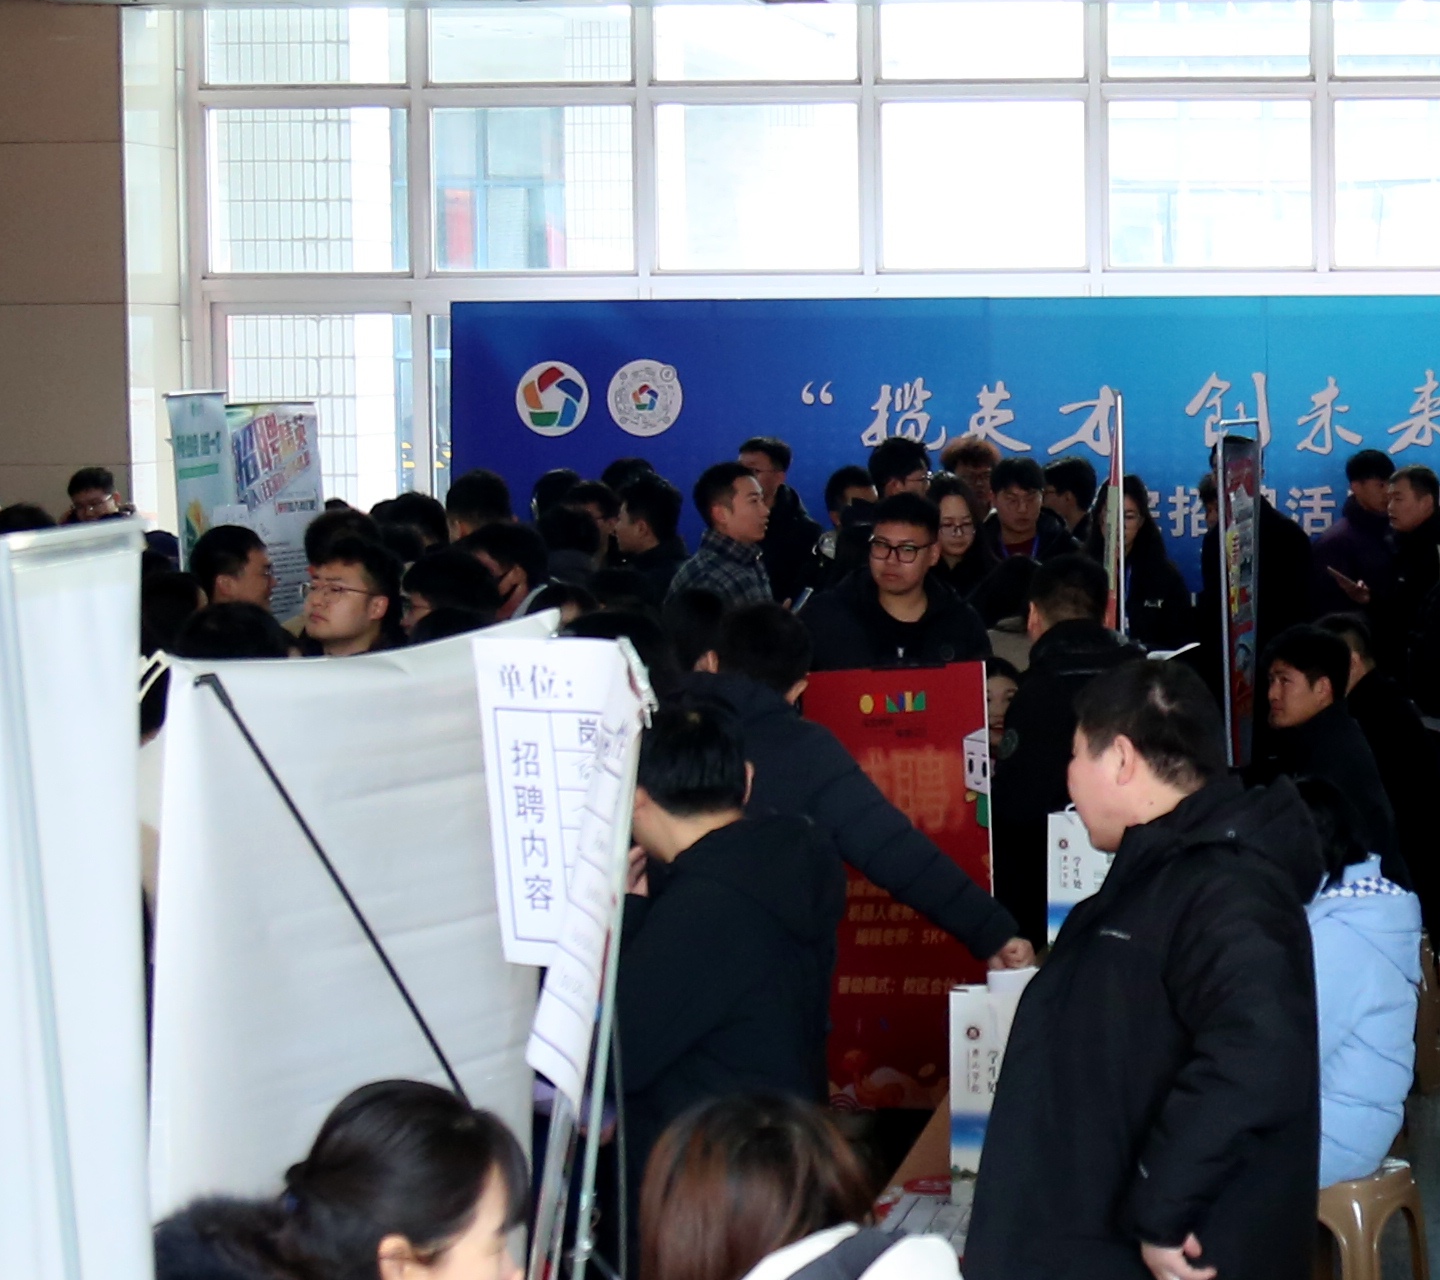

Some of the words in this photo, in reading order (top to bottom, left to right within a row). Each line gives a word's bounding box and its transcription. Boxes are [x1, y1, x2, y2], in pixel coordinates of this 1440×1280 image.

[499, 664, 574, 700] 单位：
[511, 739, 555, 913] 招聘内容
